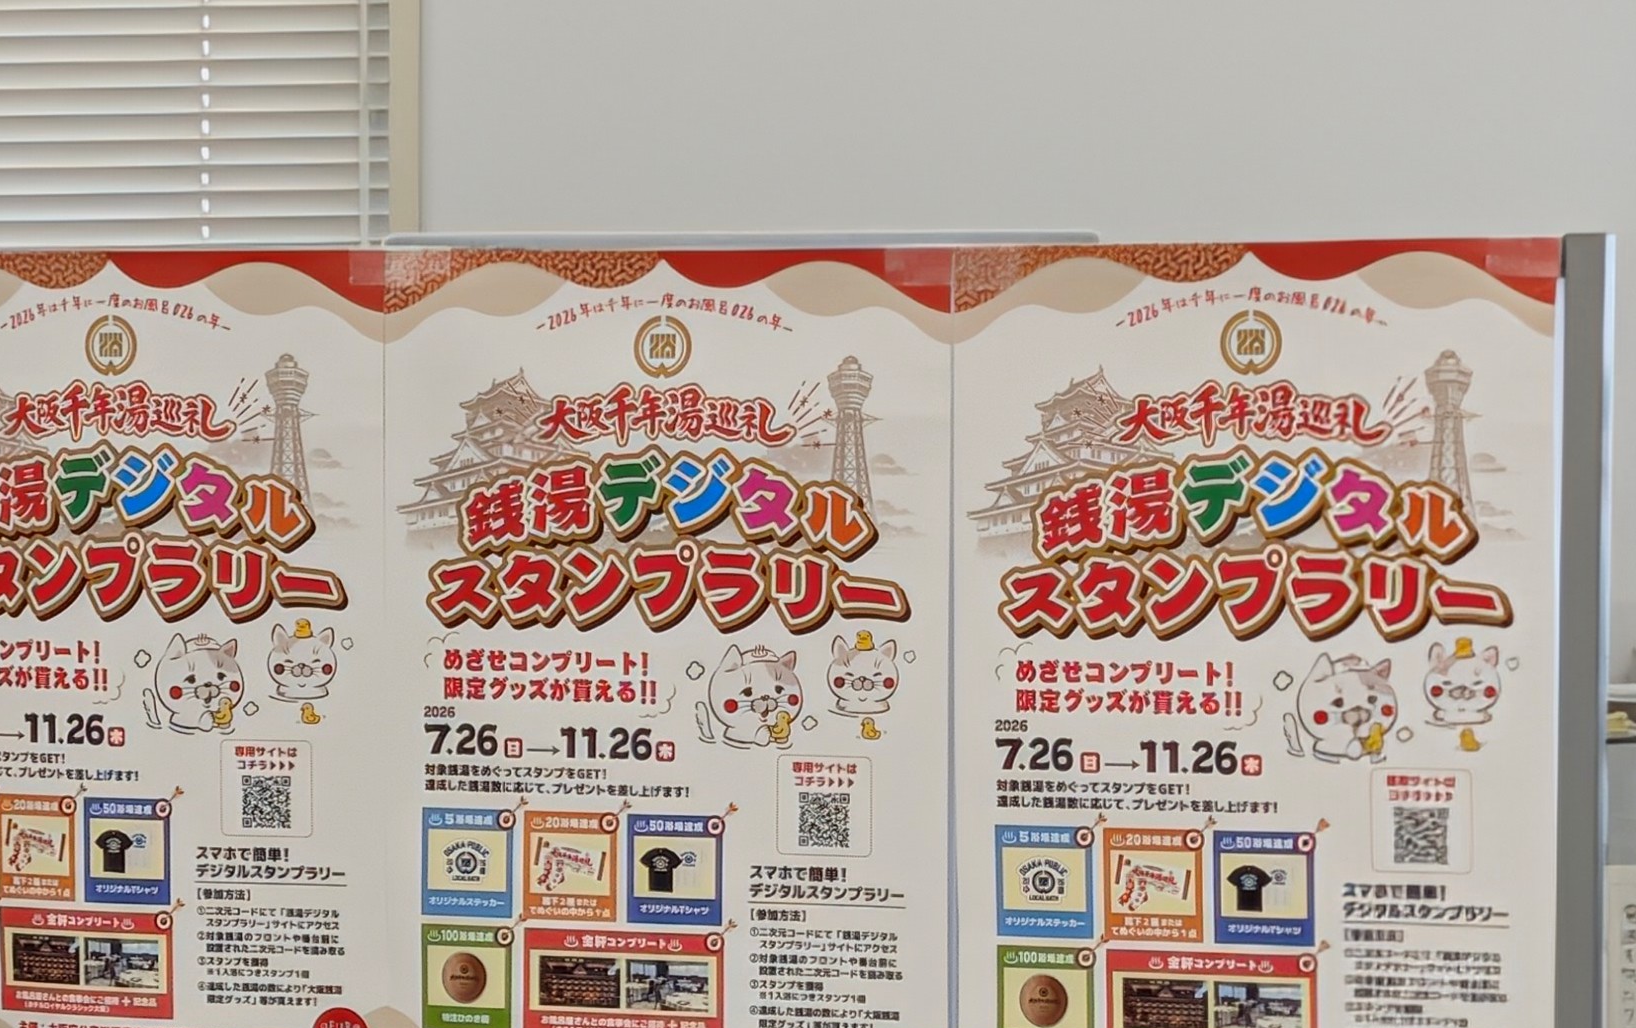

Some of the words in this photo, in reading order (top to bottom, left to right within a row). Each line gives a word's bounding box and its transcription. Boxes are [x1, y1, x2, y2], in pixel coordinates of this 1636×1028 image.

[2, 378, 238, 441] 大阪千年湯巡礼
[532, 382, 797, 447] 大阪千年湯巡礼
[1116, 379, 1394, 448] 大阪千年湯巡礼
[457, 445, 879, 563] 銭湯デジタル
[1033, 444, 1479, 565] 銭湯デジタル
[427, 534, 912, 633] スタンプラリー
[998, 547, 1513, 642] スタンプラリー
[444, 649, 648, 676] めざせコンプリート!
[1016, 660, 1234, 687] めざせコンプリート!
[444, 676, 656, 704] 限定グッズが貰える!!
[1016, 689, 1242, 717] 限定グッズが貰える!!
[424, 706, 455, 718] 2026
[995, 719, 1028, 732] 2026
[25, 713, 104, 745] 11.26
[424, 723, 498, 756] 7.26
[560, 727, 652, 760] 11.26
[235, 746, 297, 757] 専用サイトは
[995, 737, 1073, 771] 7.26
[1140, 740, 1237, 775] 11.26
[792, 762, 857, 774] 専用サイトは
[196, 847, 289, 862] スマホで簡単!
[196, 864, 345, 880] デジタルスタンプラリー
[749, 865, 847, 882] スマホで簡単!
[95, 884, 158, 894] オリジナルTシャツ
[428, 896, 504, 908] オリジナルステッカー
[749, 884, 904, 902] デジタルスタンプラリー
[640, 904, 710, 916] オリジナルTシャツ
[1005, 916, 1085, 928] オリジナルステッカー
